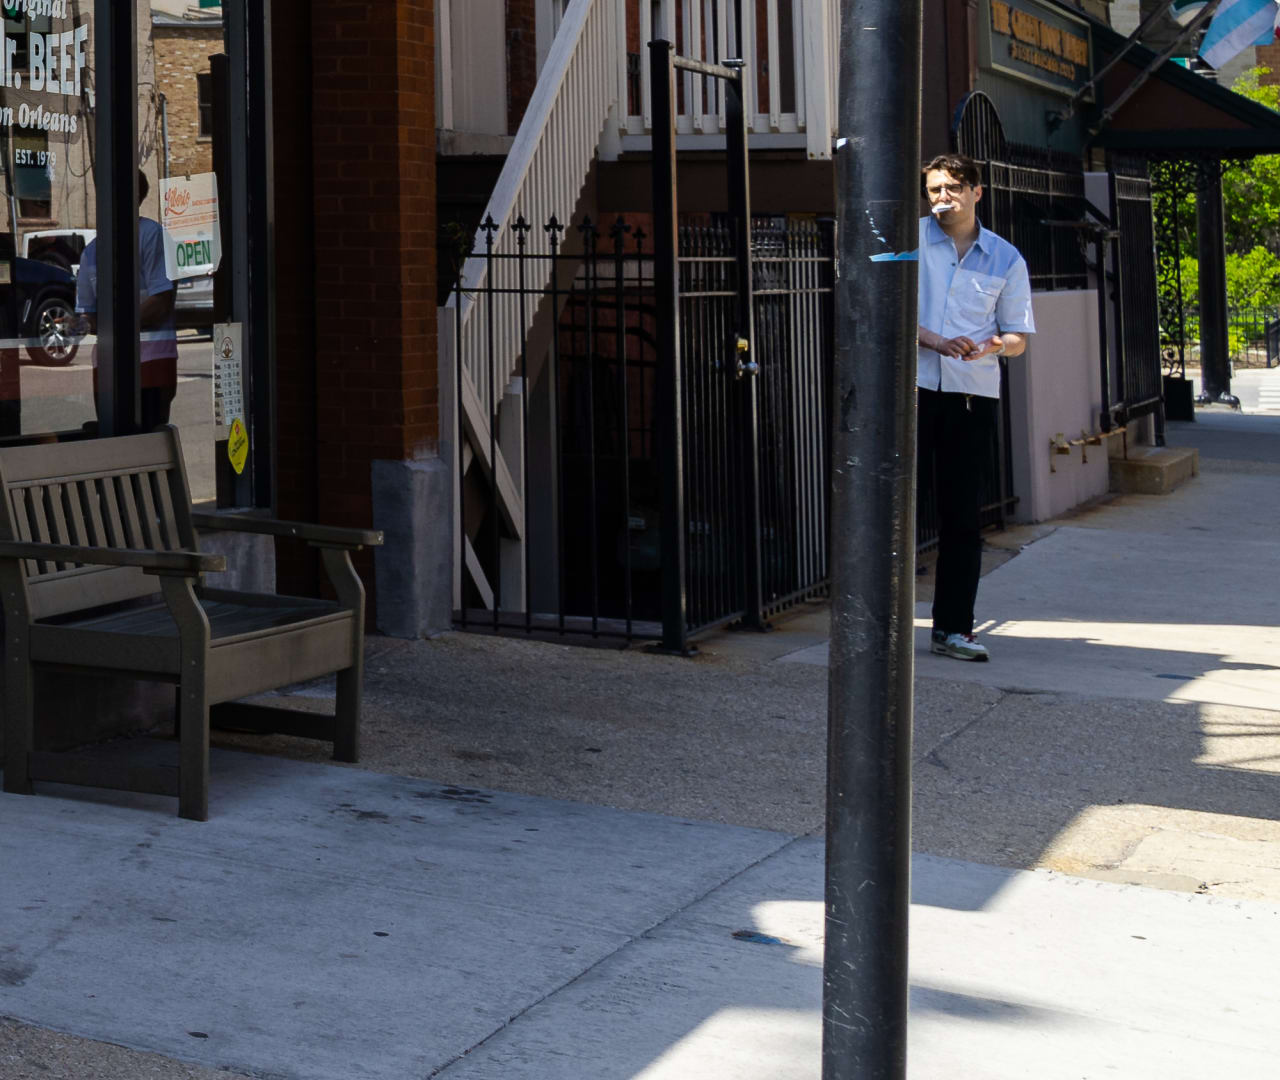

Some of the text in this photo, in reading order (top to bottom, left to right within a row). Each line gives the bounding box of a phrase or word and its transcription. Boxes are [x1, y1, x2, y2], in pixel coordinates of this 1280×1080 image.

[29, 23, 88, 97] BEEF
[18, 103, 78, 133] Orleans
[15, 148, 57, 166] EST. 1979
[176, 240, 212, 267] OPEN
